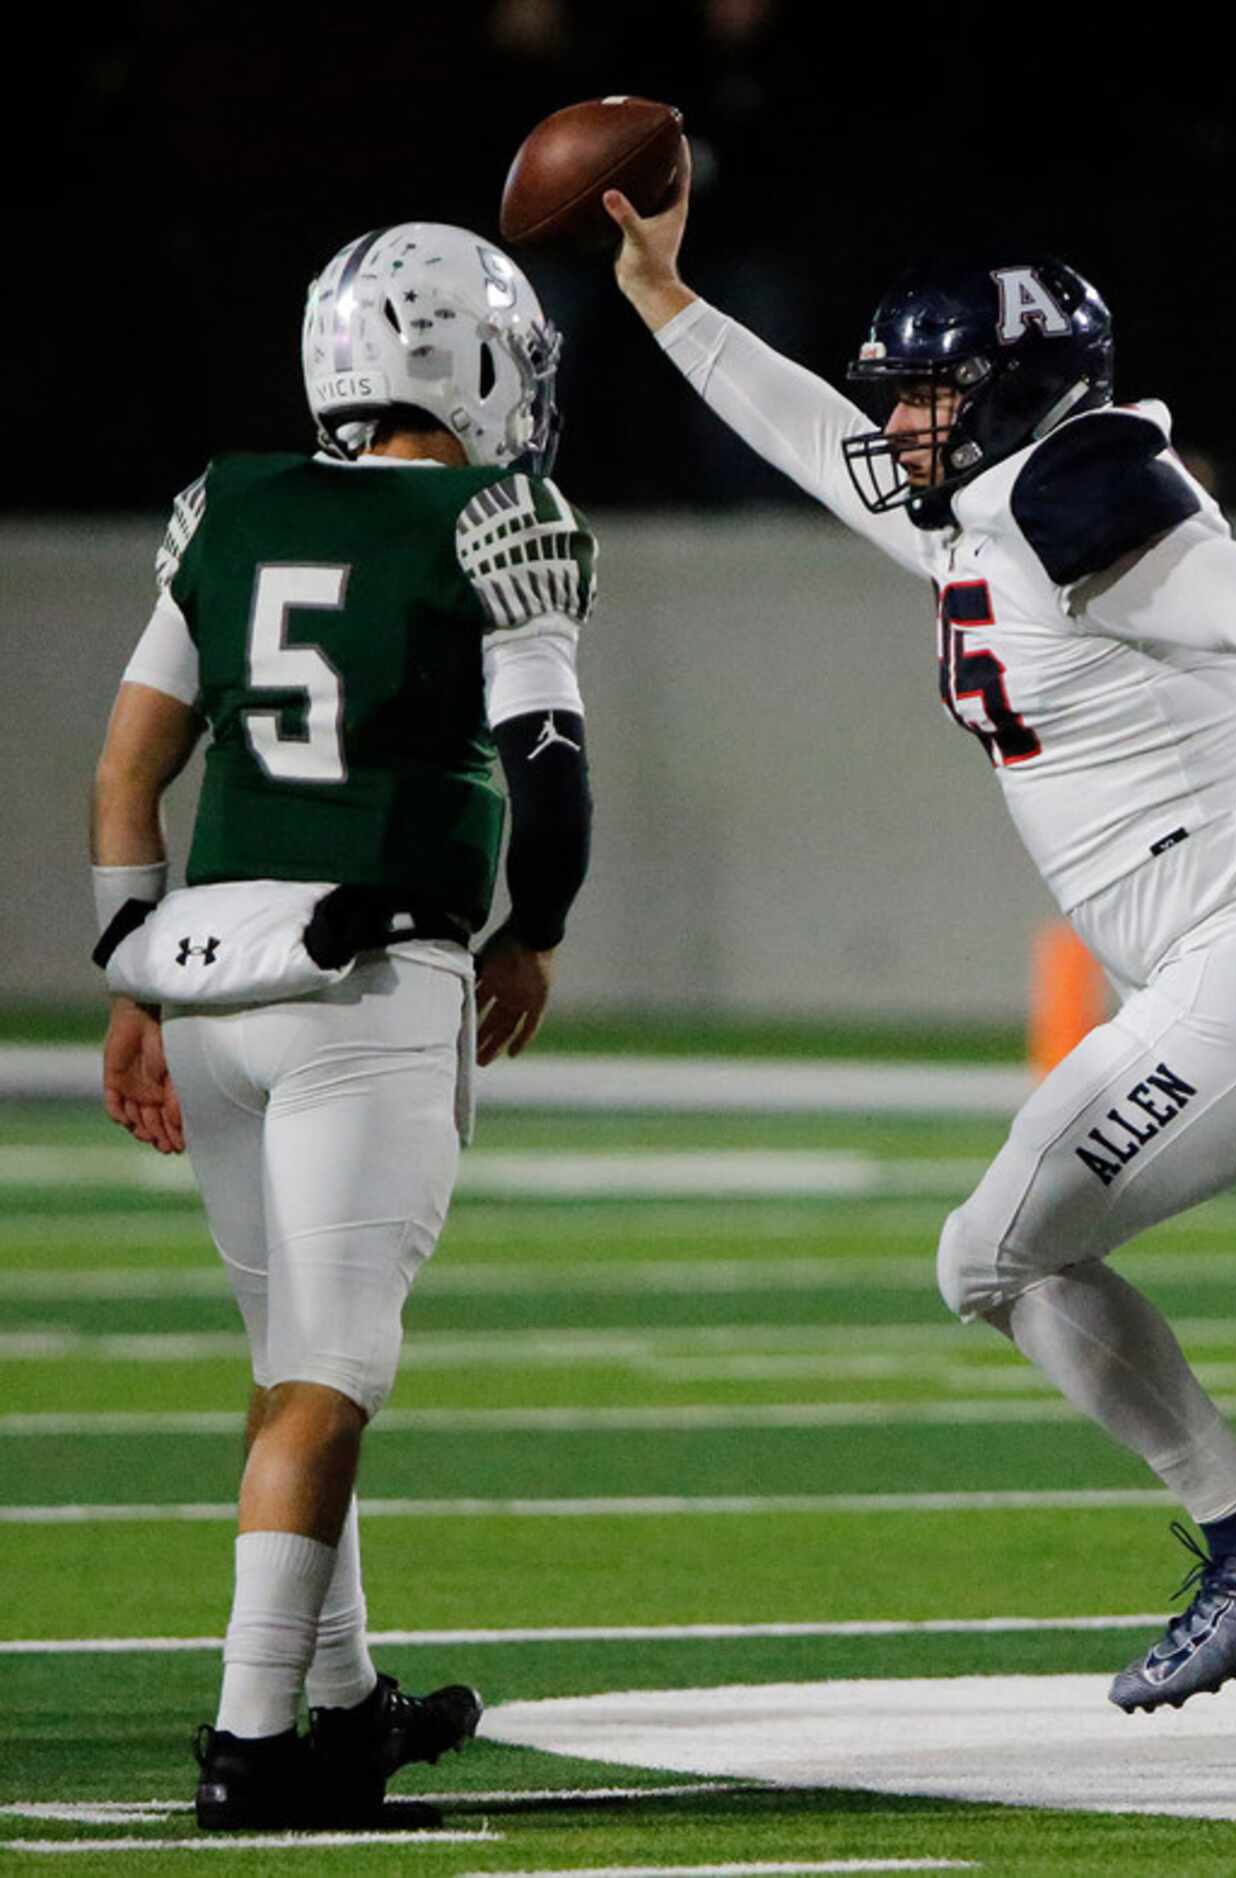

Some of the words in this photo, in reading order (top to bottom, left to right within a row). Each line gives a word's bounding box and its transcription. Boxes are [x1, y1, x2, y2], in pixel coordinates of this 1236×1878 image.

[989, 265, 1071, 344] A
[242, 562, 351, 785] 5
[1075, 1061, 1198, 1187] ALLEN
